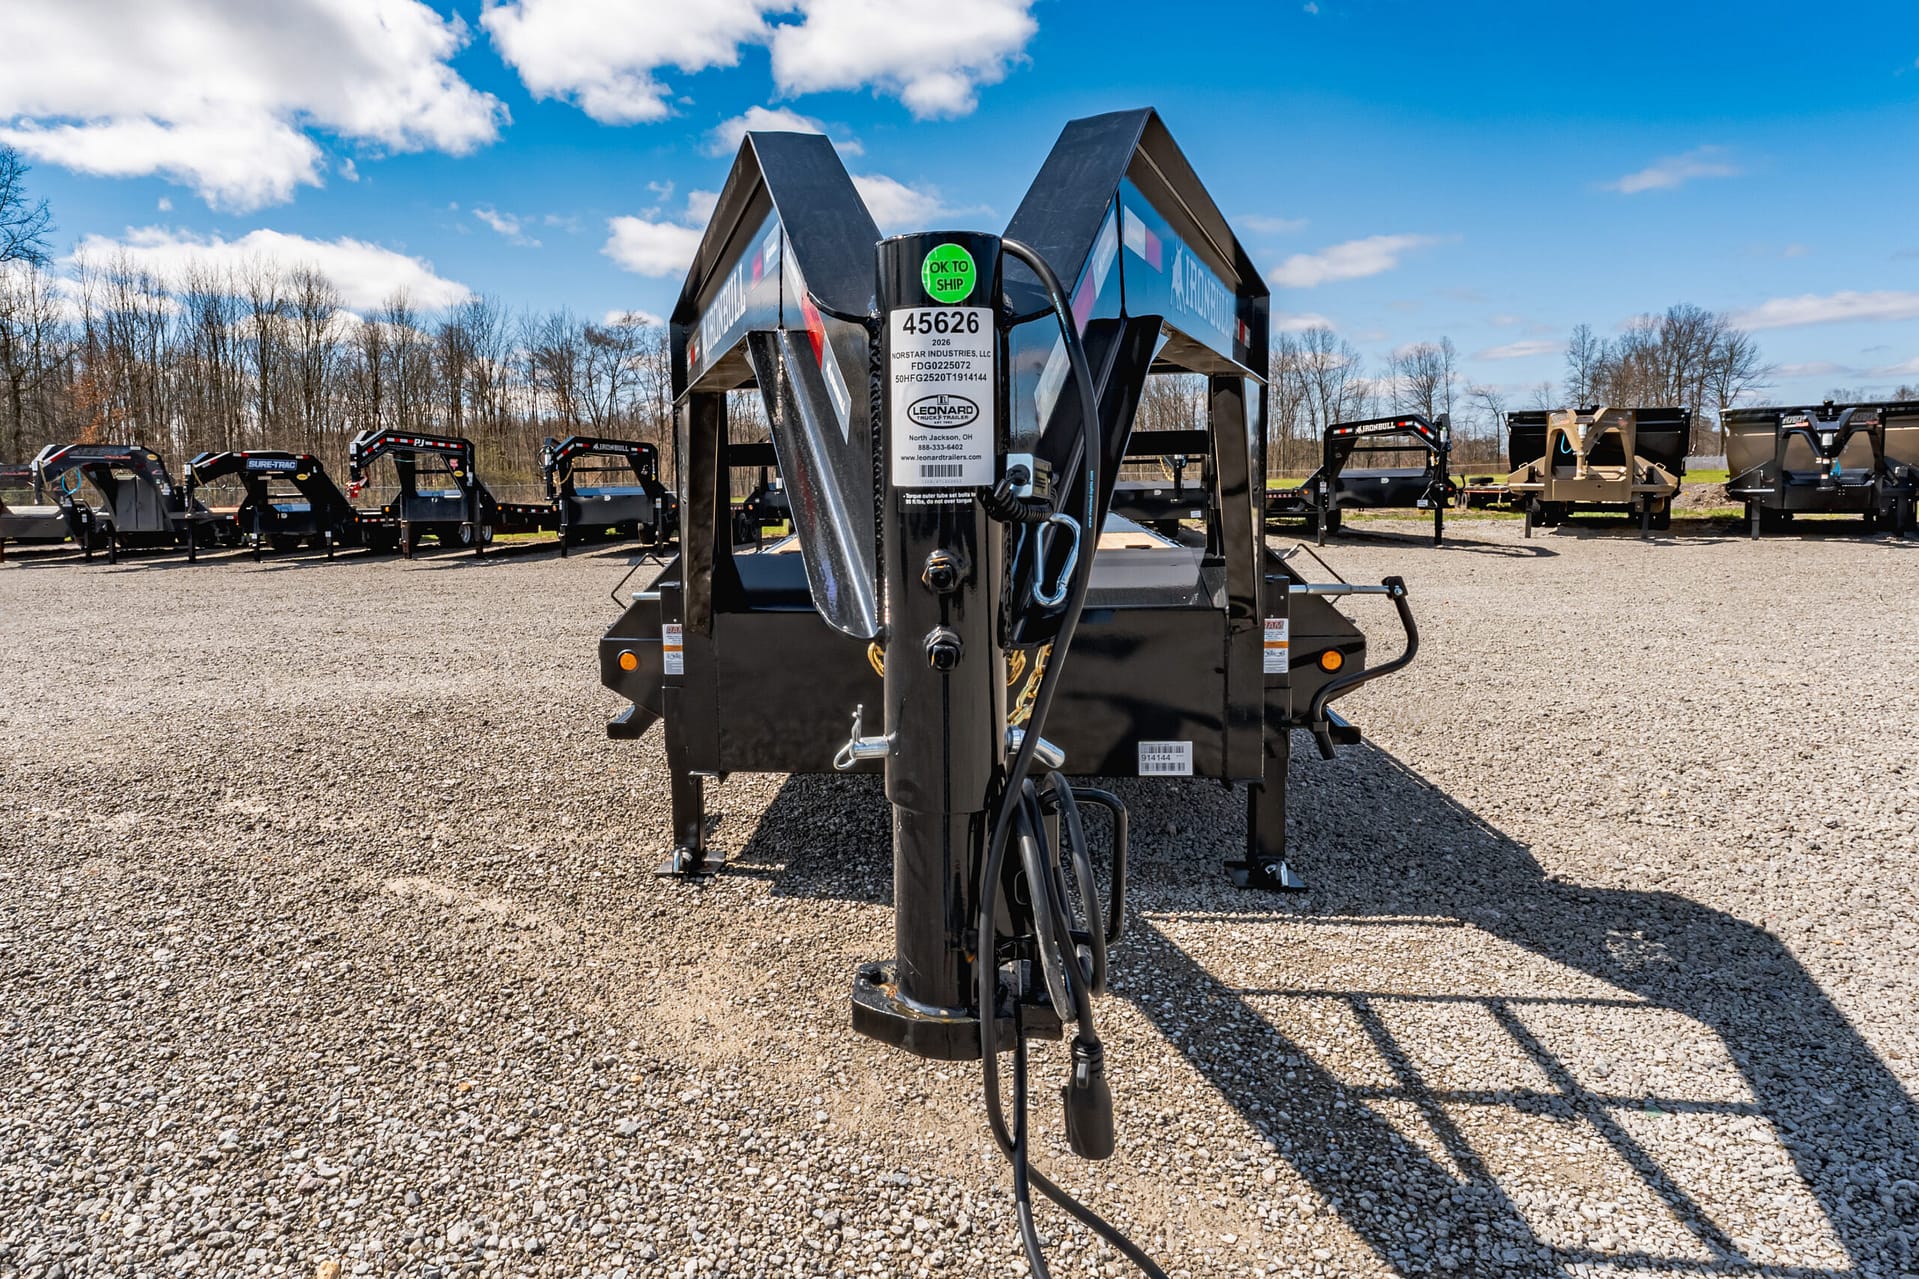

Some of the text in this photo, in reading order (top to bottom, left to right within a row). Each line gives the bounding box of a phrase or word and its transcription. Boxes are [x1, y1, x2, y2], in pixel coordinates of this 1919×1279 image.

[930, 260, 969, 274] OK TO
[936, 278, 964, 292] SHIP
[1186, 255, 1231, 337] IRONBULL
[902, 311, 979, 335] 45626
[931, 338, 951, 346] 2026
[891, 349, 992, 360] NORSTAR INDUSTRIES, LLC
[911, 361, 971, 371] FDG0225072
[913, 406, 973, 415] LEONARD
[1362, 421, 1396, 432] IRONBULL
[414, 438, 425, 447] PJ
[908, 434, 927, 442] North
[929, 434, 961, 442] Jackson,
[918, 443, 964, 451] 888-333-6402
[900, 454, 982, 462] www.leonardtrailers.com
[248, 459, 296, 470] SURE-TRAC
[1141, 754, 1171, 762] 914144
